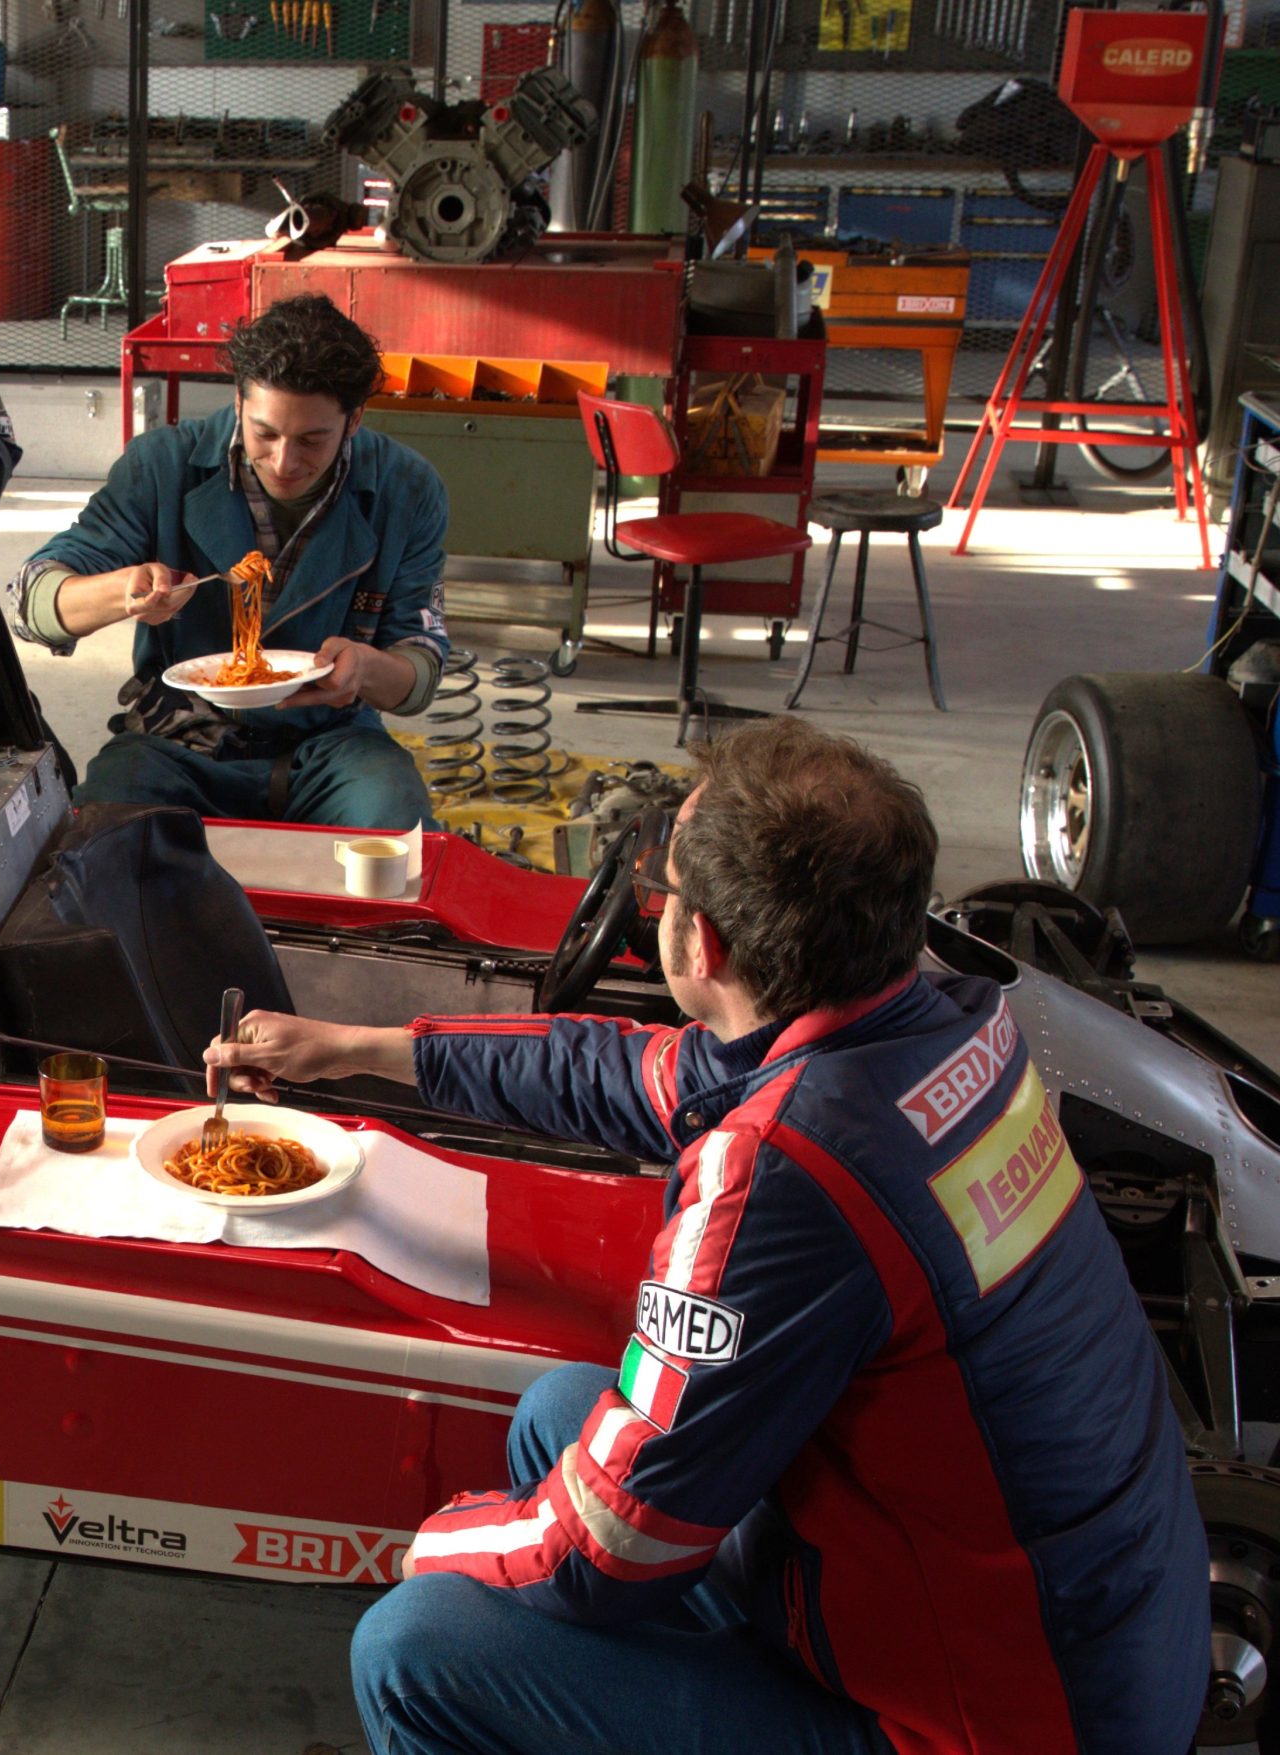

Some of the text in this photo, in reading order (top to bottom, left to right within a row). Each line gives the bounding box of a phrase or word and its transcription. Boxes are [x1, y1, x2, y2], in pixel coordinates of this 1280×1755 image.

[641, 1291, 733, 1355] PAMED
[42, 1511, 187, 1552] Veltra
[68, 1538, 187, 1560] INNOVATION BY TECNOLOGY
